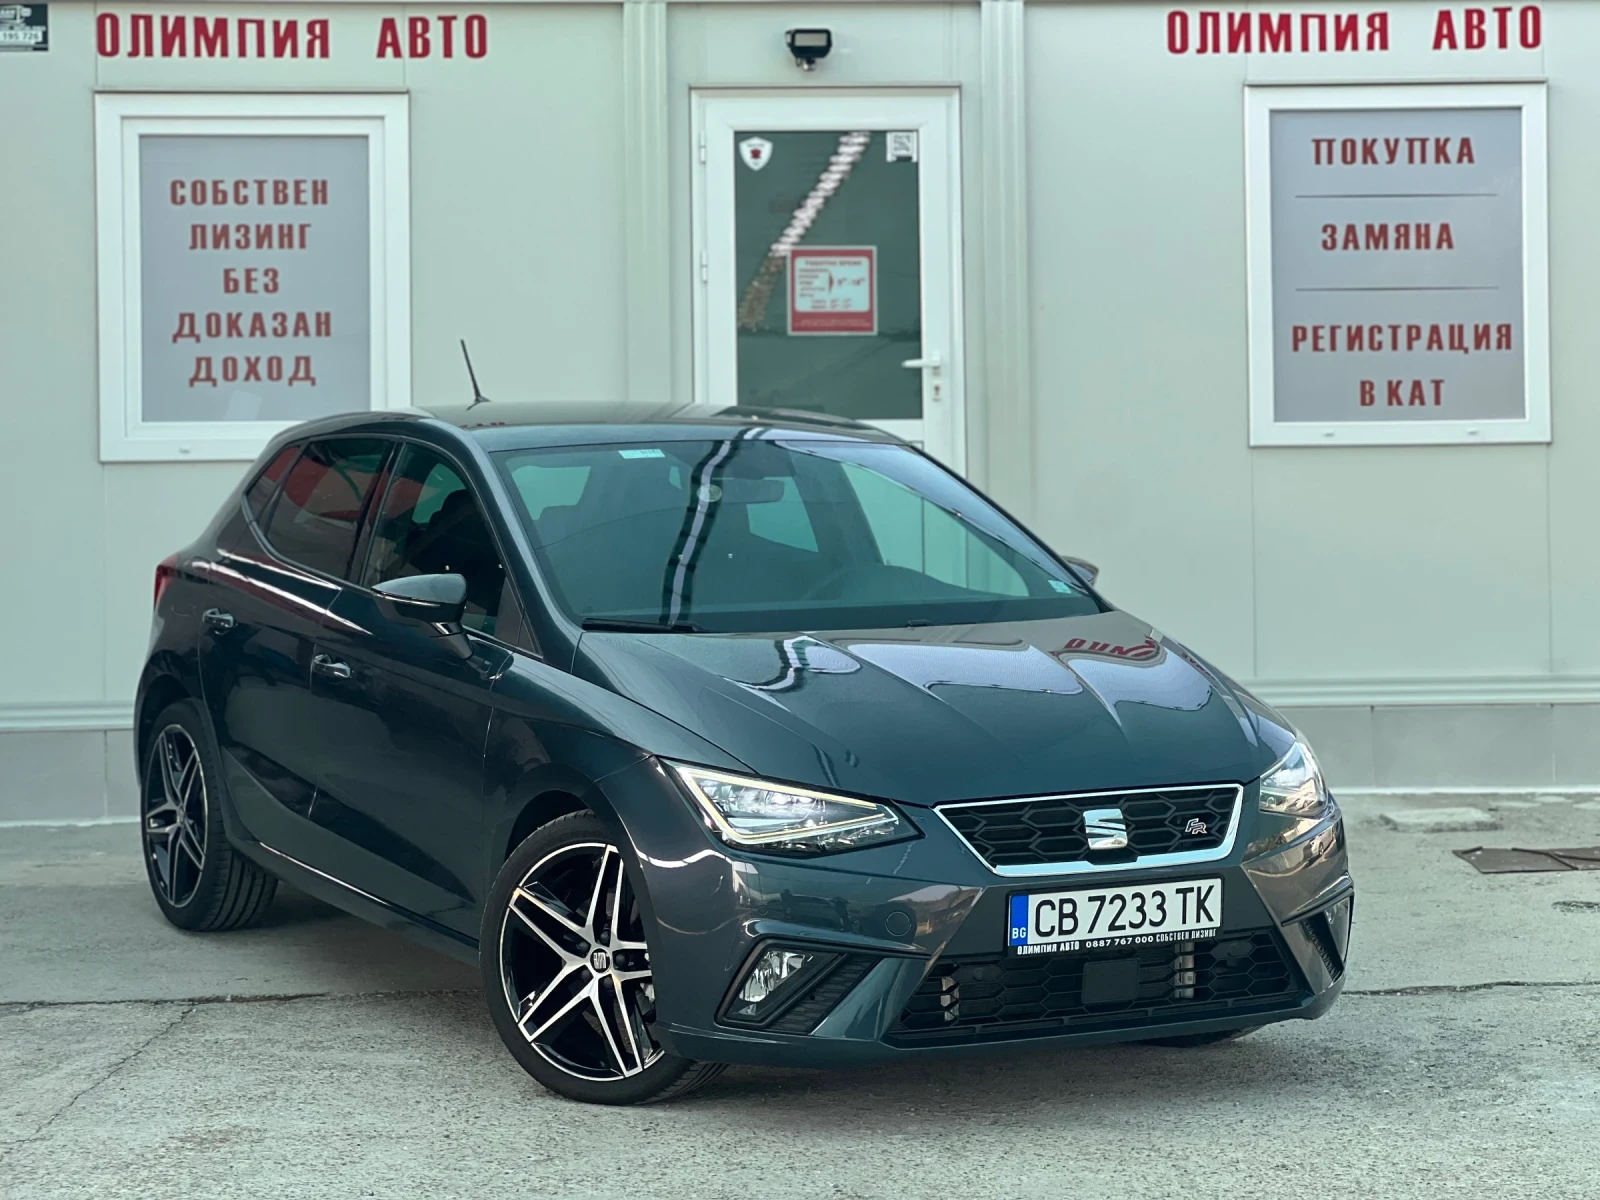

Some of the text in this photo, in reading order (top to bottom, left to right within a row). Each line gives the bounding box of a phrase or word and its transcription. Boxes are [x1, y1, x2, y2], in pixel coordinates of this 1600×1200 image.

[96, 12, 488, 59] ОЛИМПИЯ АВТО
[1166, 5, 1542, 55] ОЛИМПИЯ АВТО
[1312, 136, 1476, 165] ПОКУПКА
[170, 179, 329, 206] СОБСТВЕН
[189, 223, 312, 250] ЛИЗИНГ
[1321, 222, 1455, 251] ЗАМЯНА
[223, 267, 280, 294] БЕЗ
[172, 312, 333, 344] ДОКАЗАН
[1292, 323, 1513, 354] РЕГИСТРАЦИЯ
[189, 356, 316, 388] ДОХОД
[1359, 378, 1445, 407] В КАТ
[1012, 927, 1027, 940] BG
[1087, 891, 1167, 934] 7233
[1176, 885, 1215, 926] TK
[1017, 943, 1057, 956] ОЛИМПИЯ
[1059, 941, 1080, 952] АВТО
[1085, 939, 1111, 949] 0887
[1114, 937, 1133, 946] 767
[1135, 935, 1154, 944] 000
